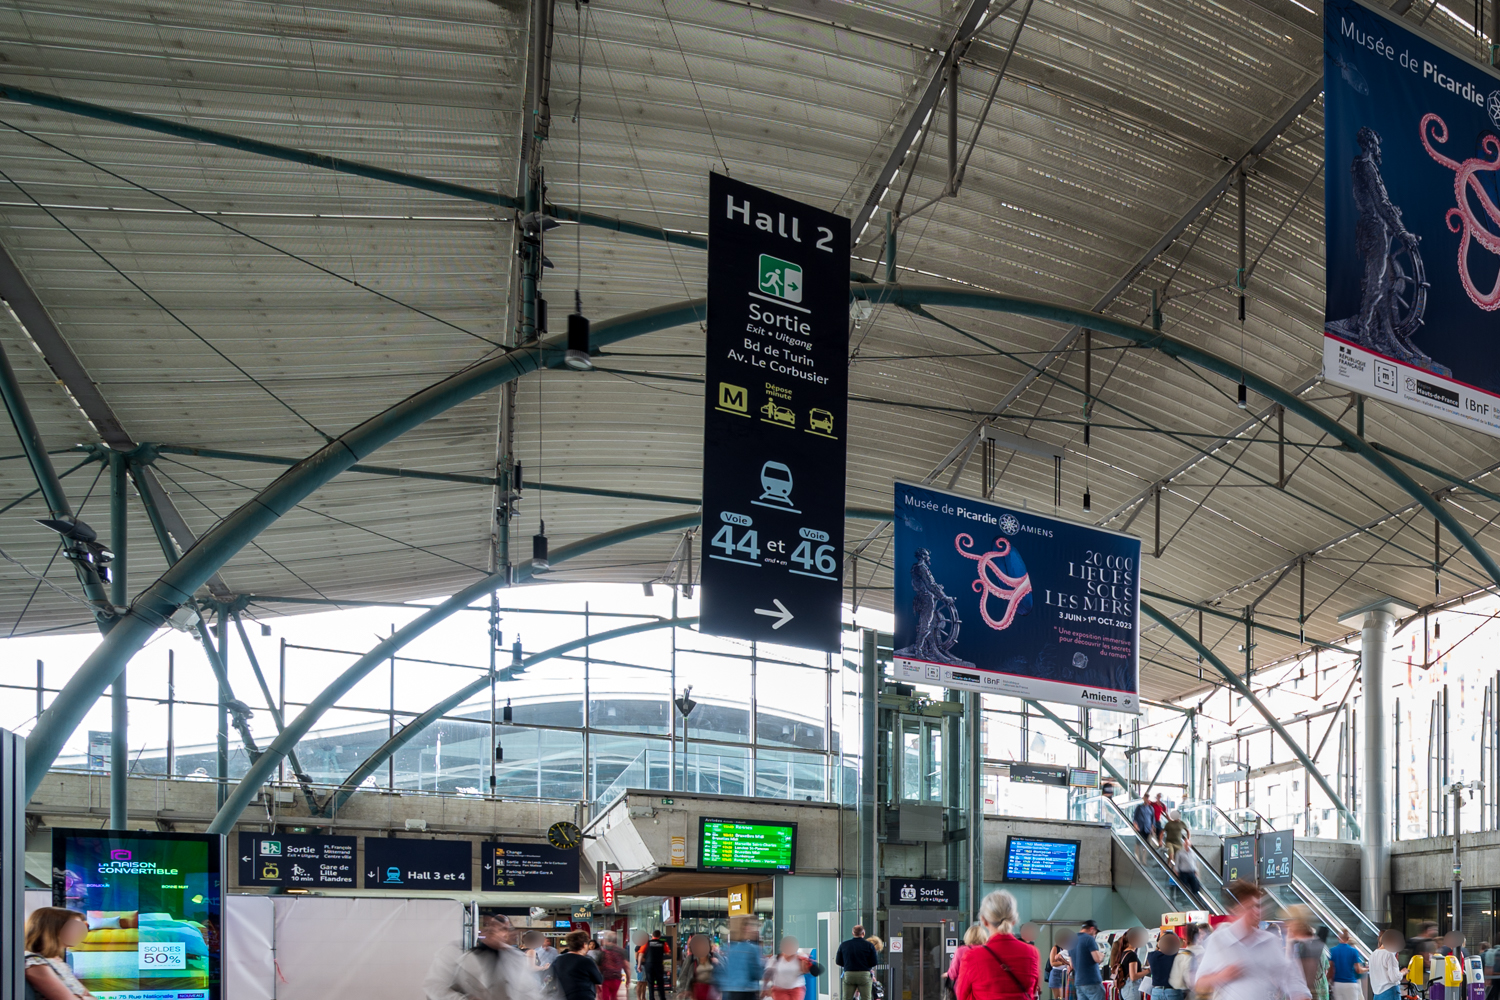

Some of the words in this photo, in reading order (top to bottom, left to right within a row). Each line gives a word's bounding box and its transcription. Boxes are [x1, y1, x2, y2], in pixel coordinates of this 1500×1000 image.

[1341, 17, 1394, 61] Musée
[1400, 49, 1419, 74] de
[1423, 60, 1485, 108] Picardie
[727, 194, 801, 243] Hall
[816, 226, 834, 253] 2
[748, 303, 811, 336] Sortie
[746, 323, 765, 337] Exit
[775, 331, 813, 351] Uitgang
[744, 338, 760, 352] Bd
[764, 342, 779, 358] de
[784, 349, 814, 367] Turin
[1338, 352, 1366, 368] RÉPUBLIQUE
[727, 349, 748, 364] Av.
[752, 354, 766, 369] Le
[769, 360, 829, 385] Corbusier
[1338, 359, 1364, 372] FRANÇAISE
[723, 387, 743, 408] M
[765, 382, 793, 395] Dépose
[765, 389, 792, 401] minute
[1417, 388, 1458, 407] Hauts-de-France
[1469, 399, 1489, 415] BnF
[725, 513, 748, 525] Voie
[904, 494, 938, 511] Musée
[941, 504, 954, 515] de
[957, 507, 997, 525] Picardie
[803, 529, 825, 541] Voie
[1021, 524, 1053, 538] AMIENS
[711, 525, 760, 560] 44
[767, 539, 785, 554] et
[790, 541, 836, 574] 46
[1085, 550, 1102, 567] 20
[1106, 555, 1133, 571] 000
[1068, 562, 1132, 586] LIEUES
[1087, 580, 1132, 602] SOUS
[1045, 589, 1078, 610] LES
[1083, 596, 1132, 618] MERS
[1059, 611, 1064, 619] 3
[1064, 612, 1082, 622] JUIN
[1097, 617, 1115, 627] OCT.
[1116, 620, 1132, 630] 2023
[1059, 636, 1073, 644] pour
[1074, 637, 1101, 648] découvrir
[1102, 642, 1110, 650] les
[1111, 645, 1131, 653] secrets
[1072, 630, 1101, 641] exposition
[1103, 636, 1131, 646] immersive
[1081, 689, 1118, 704] Amiens
[408, 871, 431, 879] Hall
[434, 872, 441, 880] 3
[443, 872, 456, 880] et
[1266, 863, 1275, 876] 44
[1280, 862, 1289, 875] 46
[604, 874, 612, 903] TABAC
[920, 888, 944, 896] Sortie
[574, 911, 592, 919] avril
[144, 953, 180, 963] 50%
